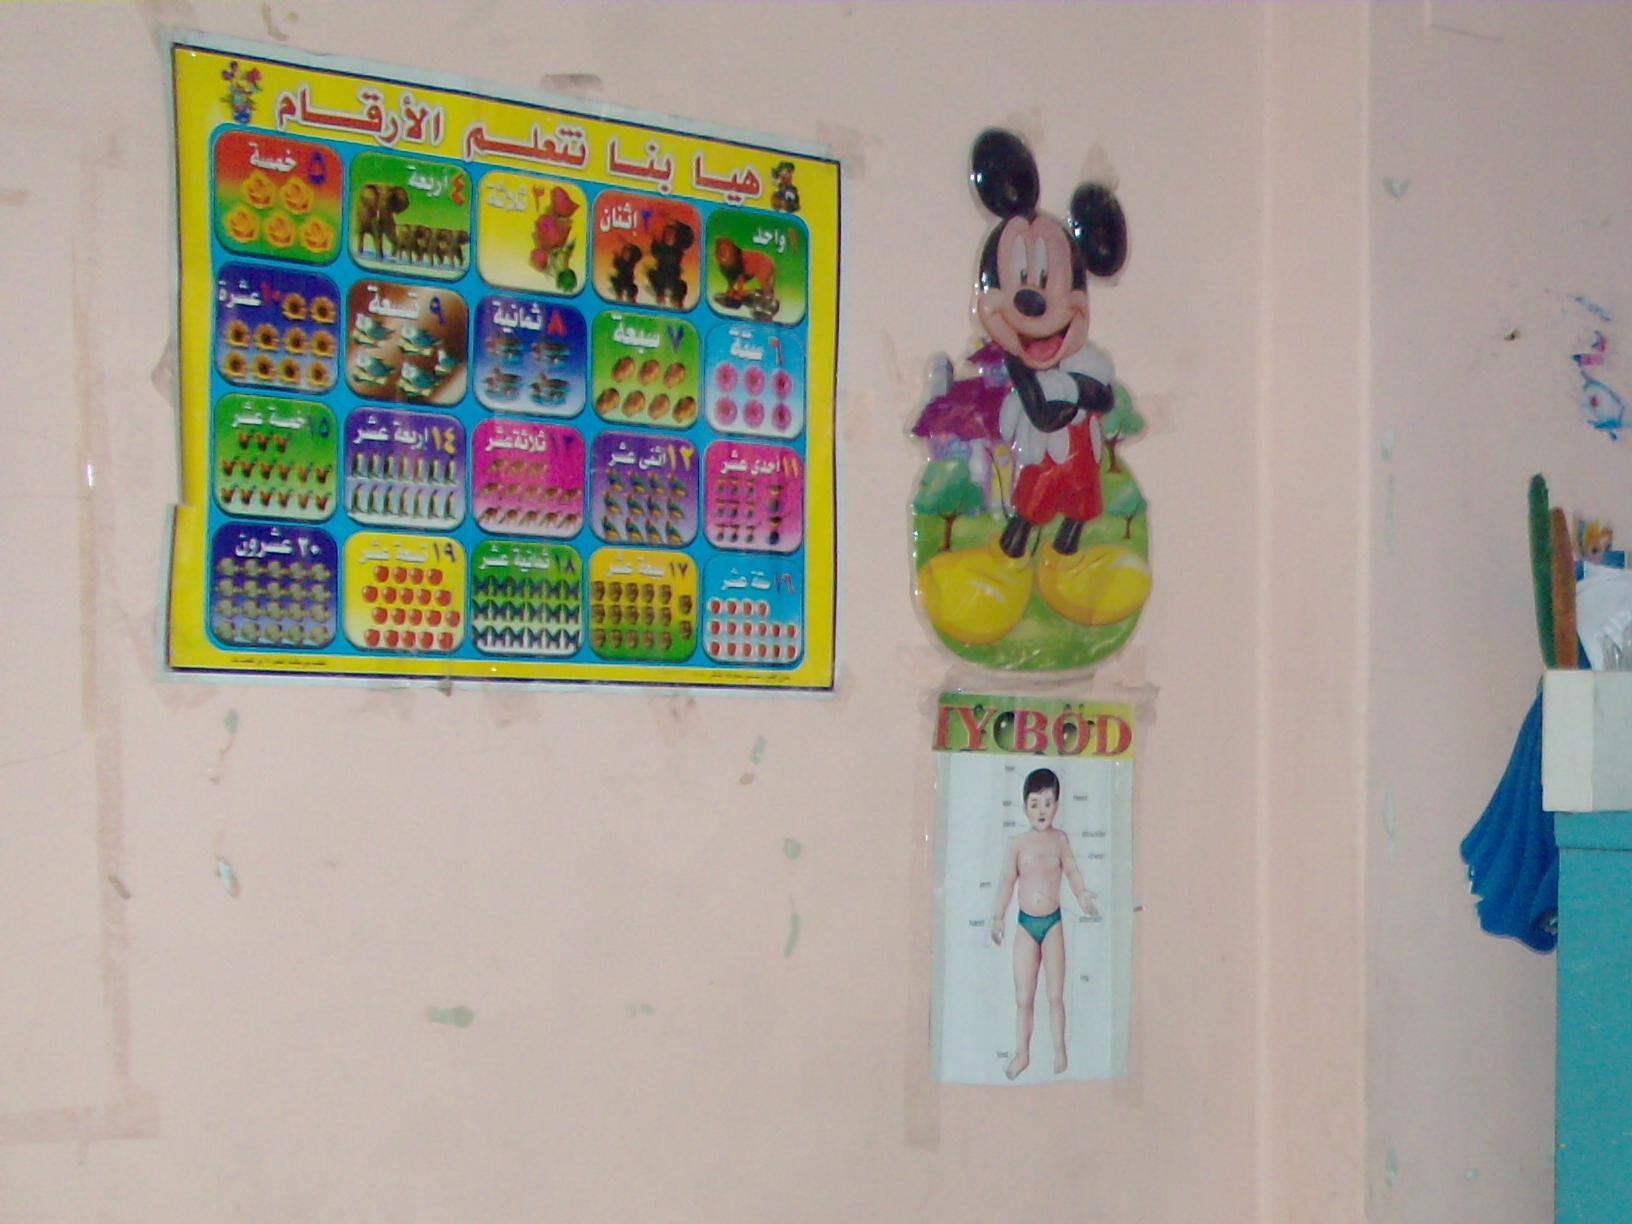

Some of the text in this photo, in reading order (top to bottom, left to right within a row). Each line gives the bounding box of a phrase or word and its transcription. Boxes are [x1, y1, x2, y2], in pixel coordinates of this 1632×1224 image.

[249, 142, 297, 172] خمسة
[276, 84, 763, 205] هيا بنا نتعلم الأرقام
[753, 228, 786, 253] واحد
[219, 280, 261, 308] عشرة
[367, 284, 420, 319] تسعة
[491, 301, 543, 333] ثمانية
[611, 312, 661, 353] سبعة
[728, 329, 765, 361] ستة
[352, 415, 389, 444] عشر
[608, 442, 636, 467] عشر
[721, 450, 748, 474] عشر
[235, 527, 293, 558] عشرون
